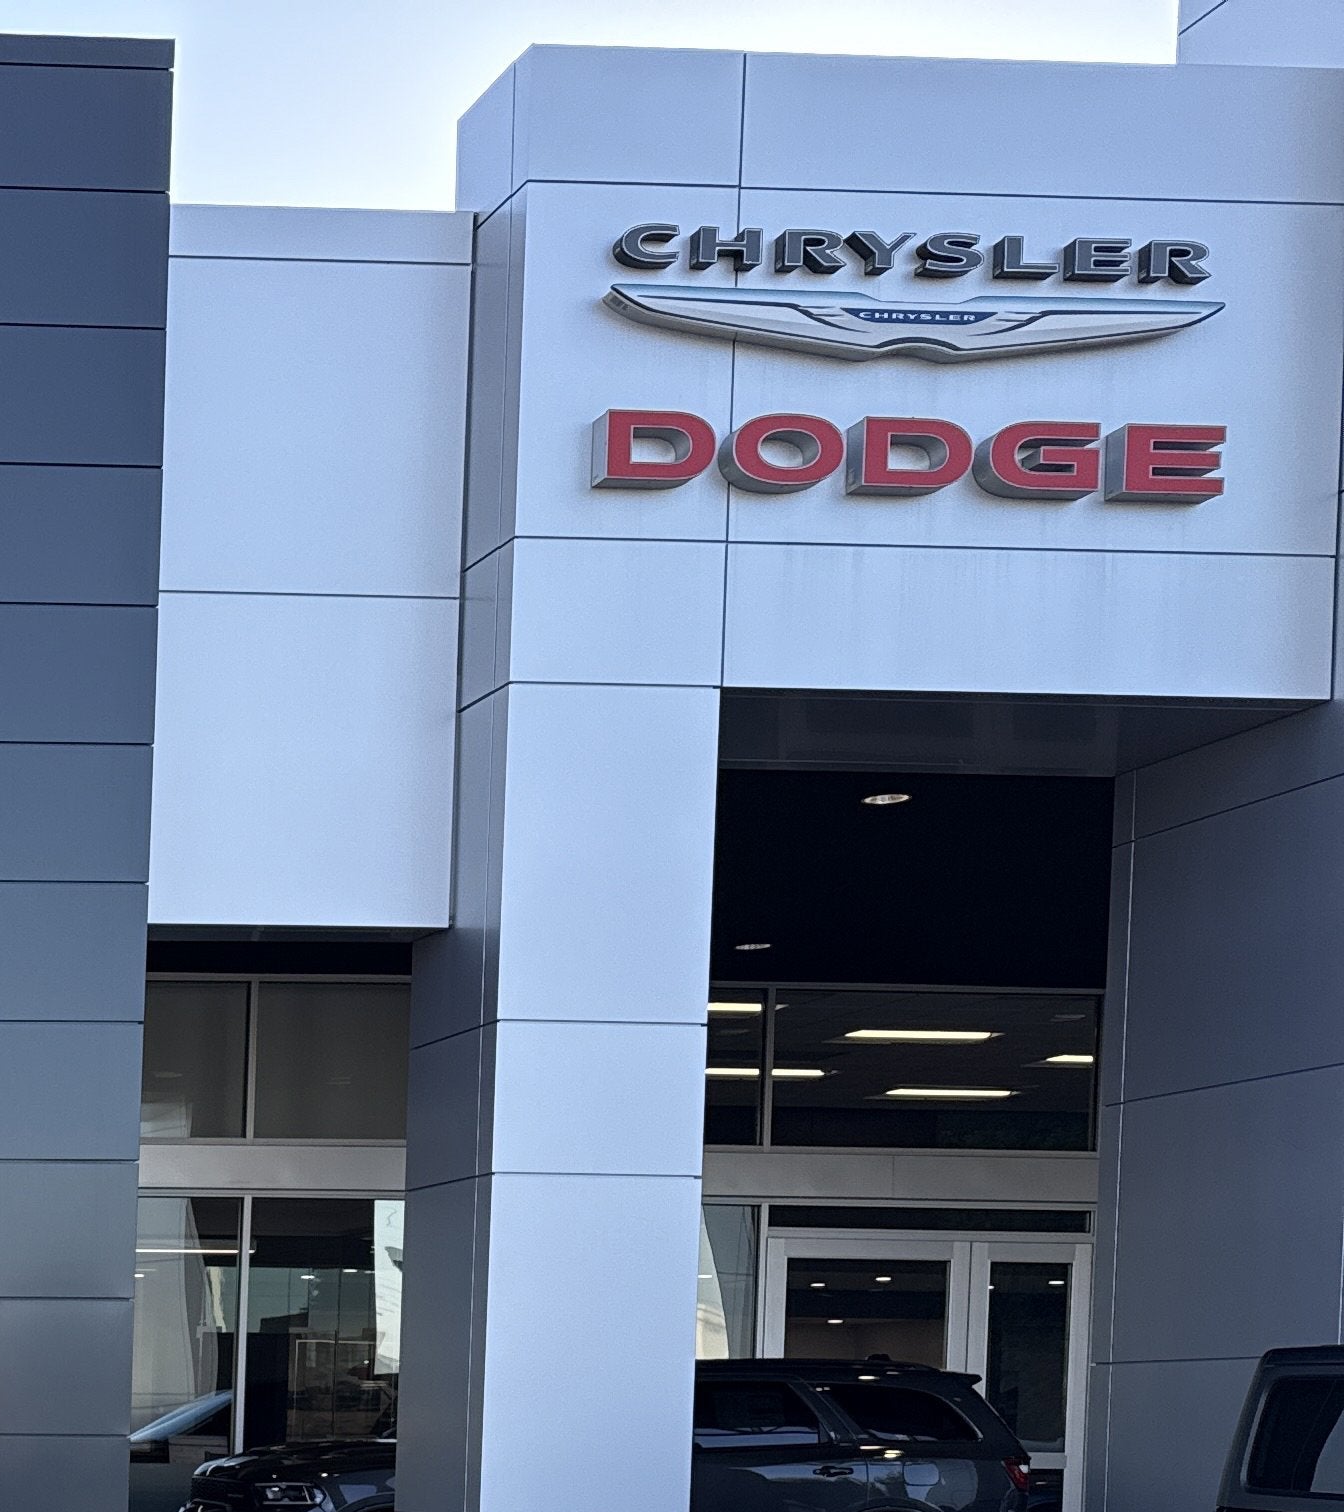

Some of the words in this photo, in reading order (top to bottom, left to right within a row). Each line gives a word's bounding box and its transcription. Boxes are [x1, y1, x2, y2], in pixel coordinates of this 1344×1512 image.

[612, 223, 1212, 284] CHRYSLER
[859, 311, 976, 321] CHRYSLER
[591, 409, 1227, 505] DODGE
